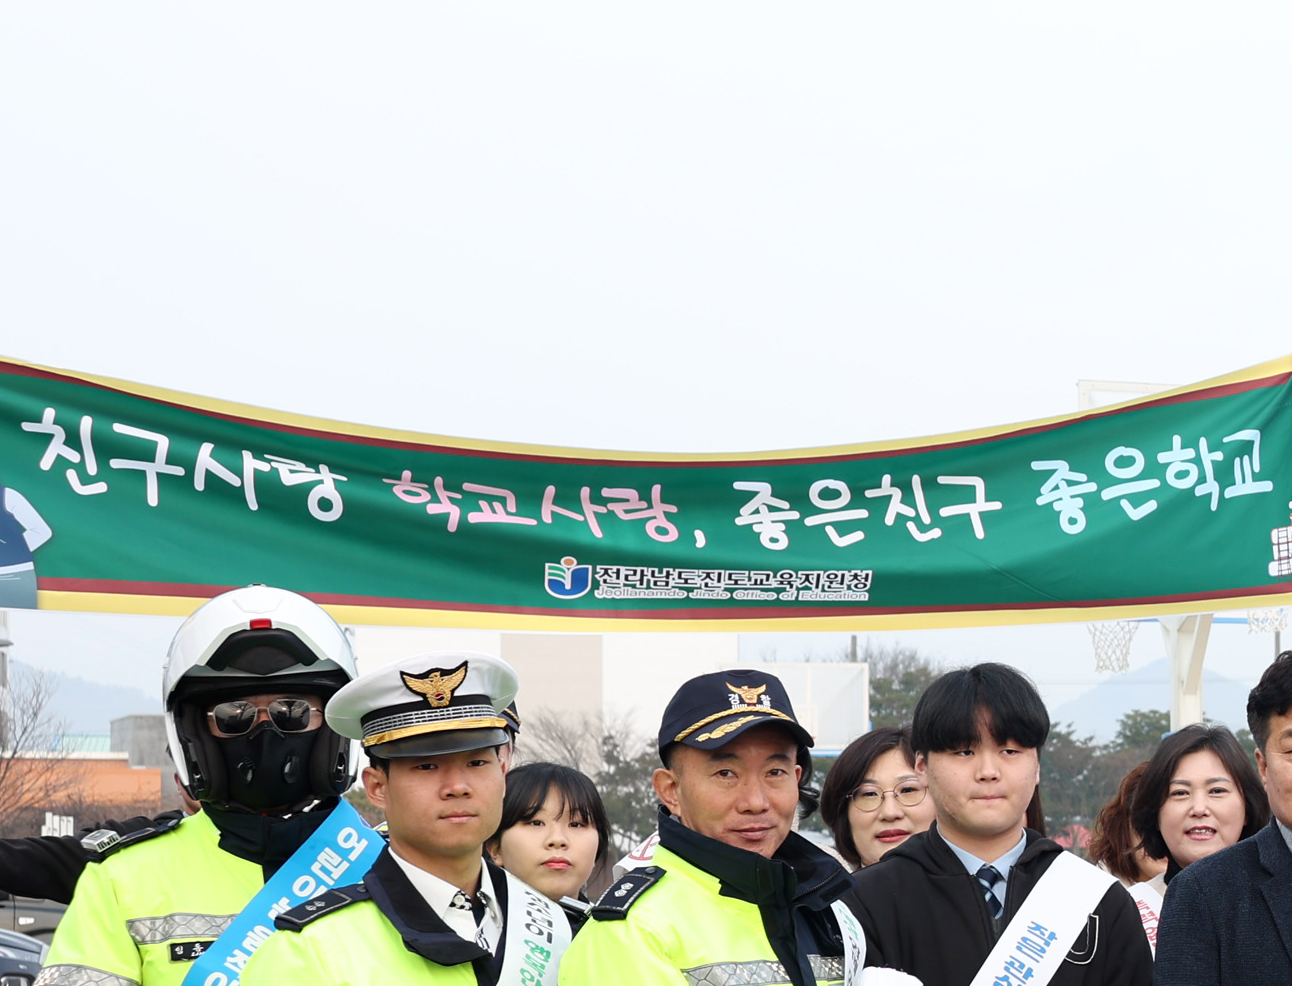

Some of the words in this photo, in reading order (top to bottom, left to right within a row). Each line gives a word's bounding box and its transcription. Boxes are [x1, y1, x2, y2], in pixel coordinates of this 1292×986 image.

[20, 405, 348, 523] 친구사랑
[382, 469, 706, 549] 학교사랑,
[733, 473, 1002, 551] 좋은친구
[1030, 430, 1274, 536] 좋은학교
[595, 565, 872, 592] 전라남도진도교육지원청
[689, 588, 730, 599] Jindo
[734, 589, 776, 600] Office
[799, 590, 869, 601] Education
